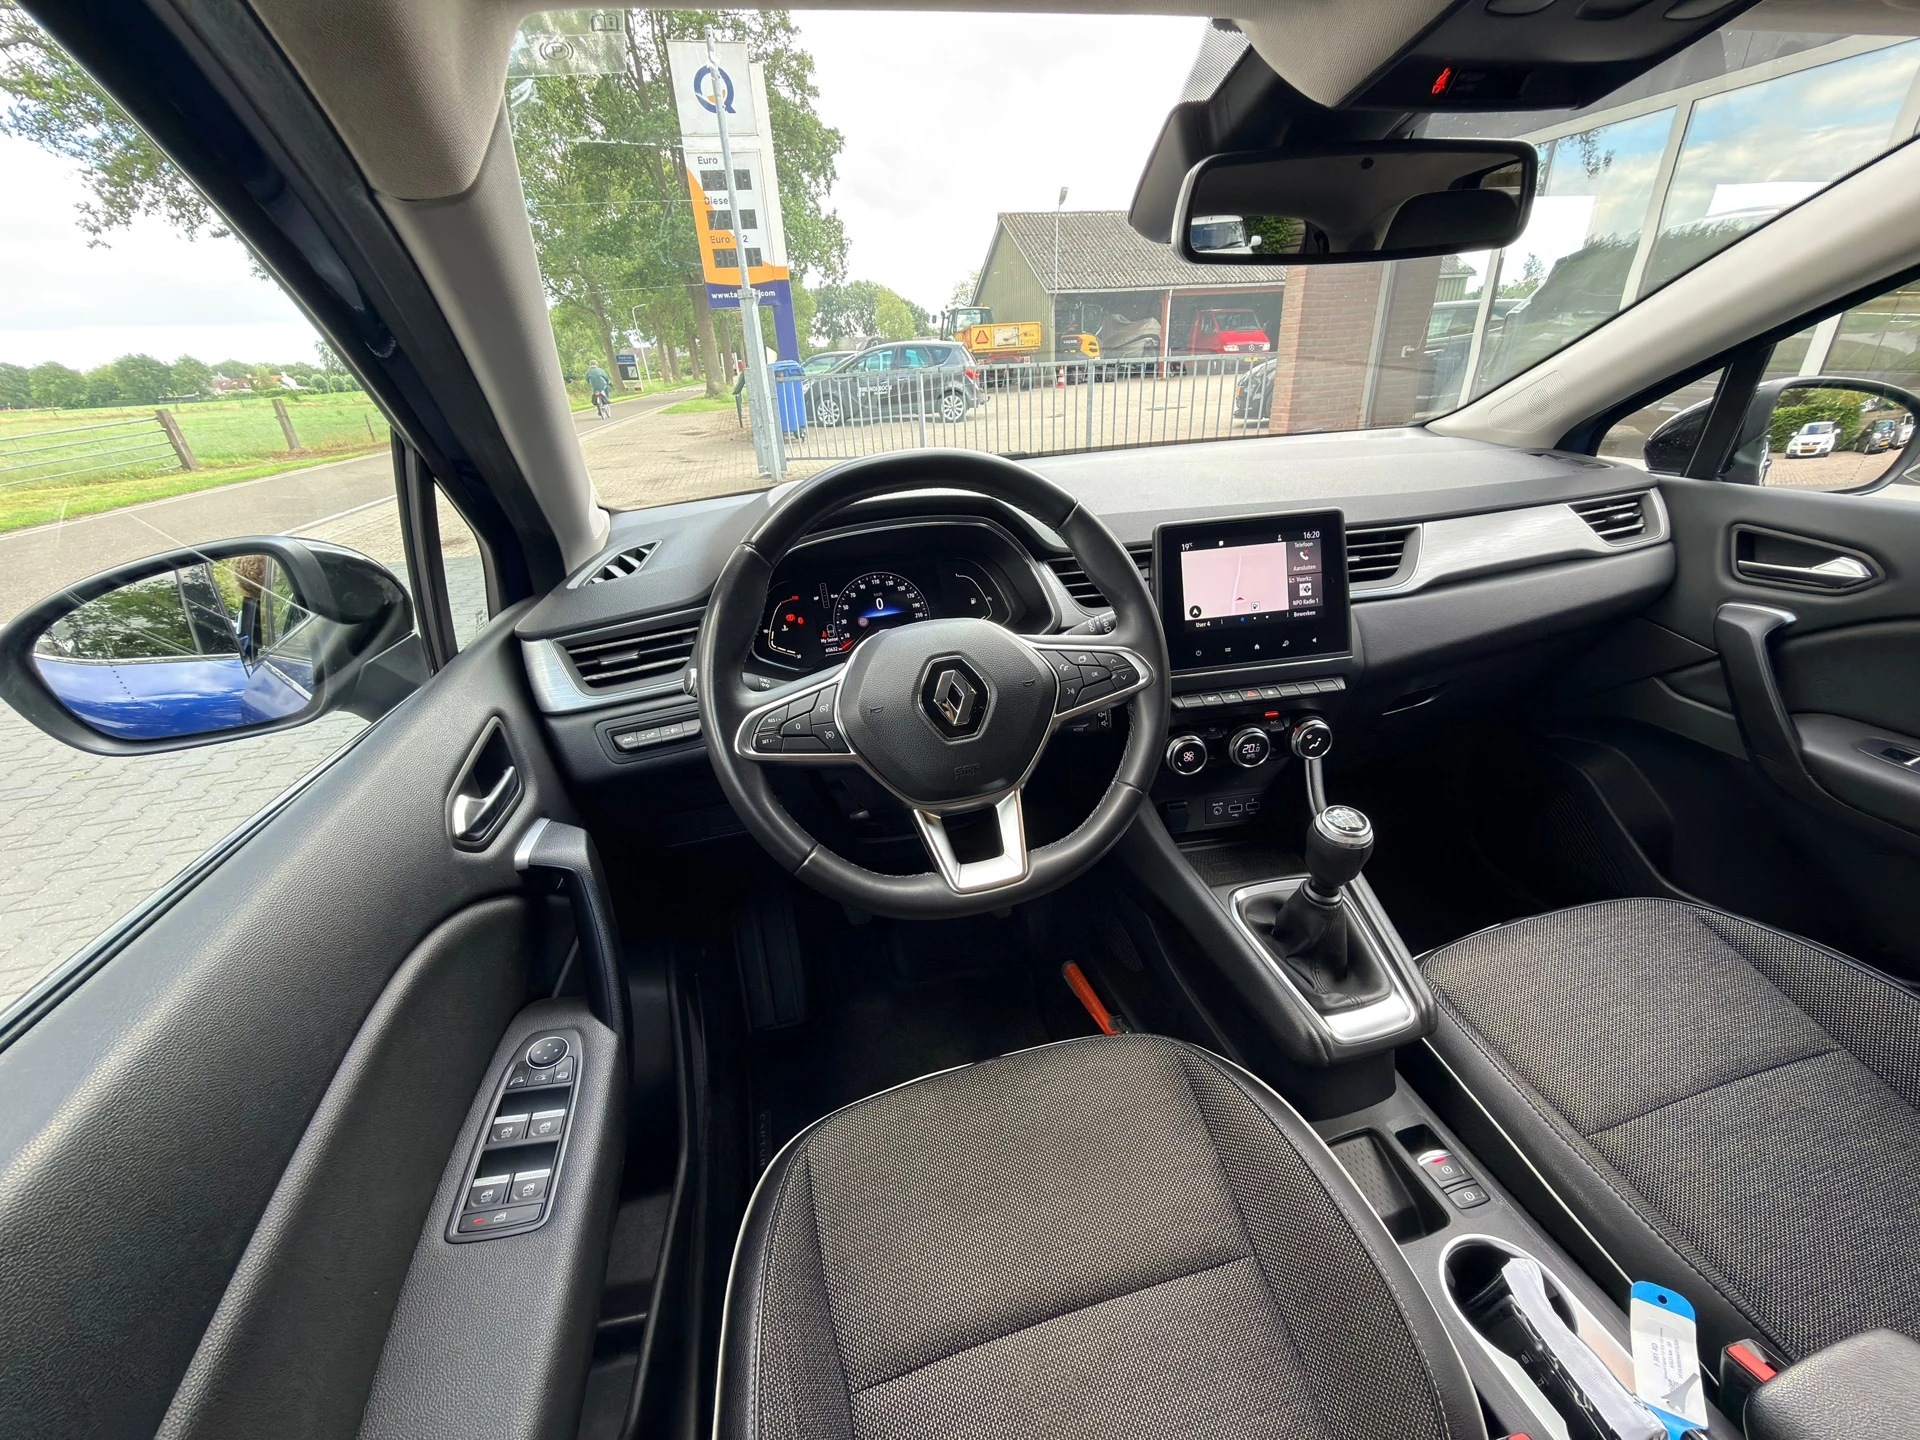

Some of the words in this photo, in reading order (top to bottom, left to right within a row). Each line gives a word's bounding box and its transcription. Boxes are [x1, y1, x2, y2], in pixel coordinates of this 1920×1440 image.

[694, 65, 736, 113] Q
[697, 156, 718, 164] Euro
[704, 197, 729, 205] Diese
[1303, 531, 1320, 539] 16:20
[876, 597, 883, 610] 0
